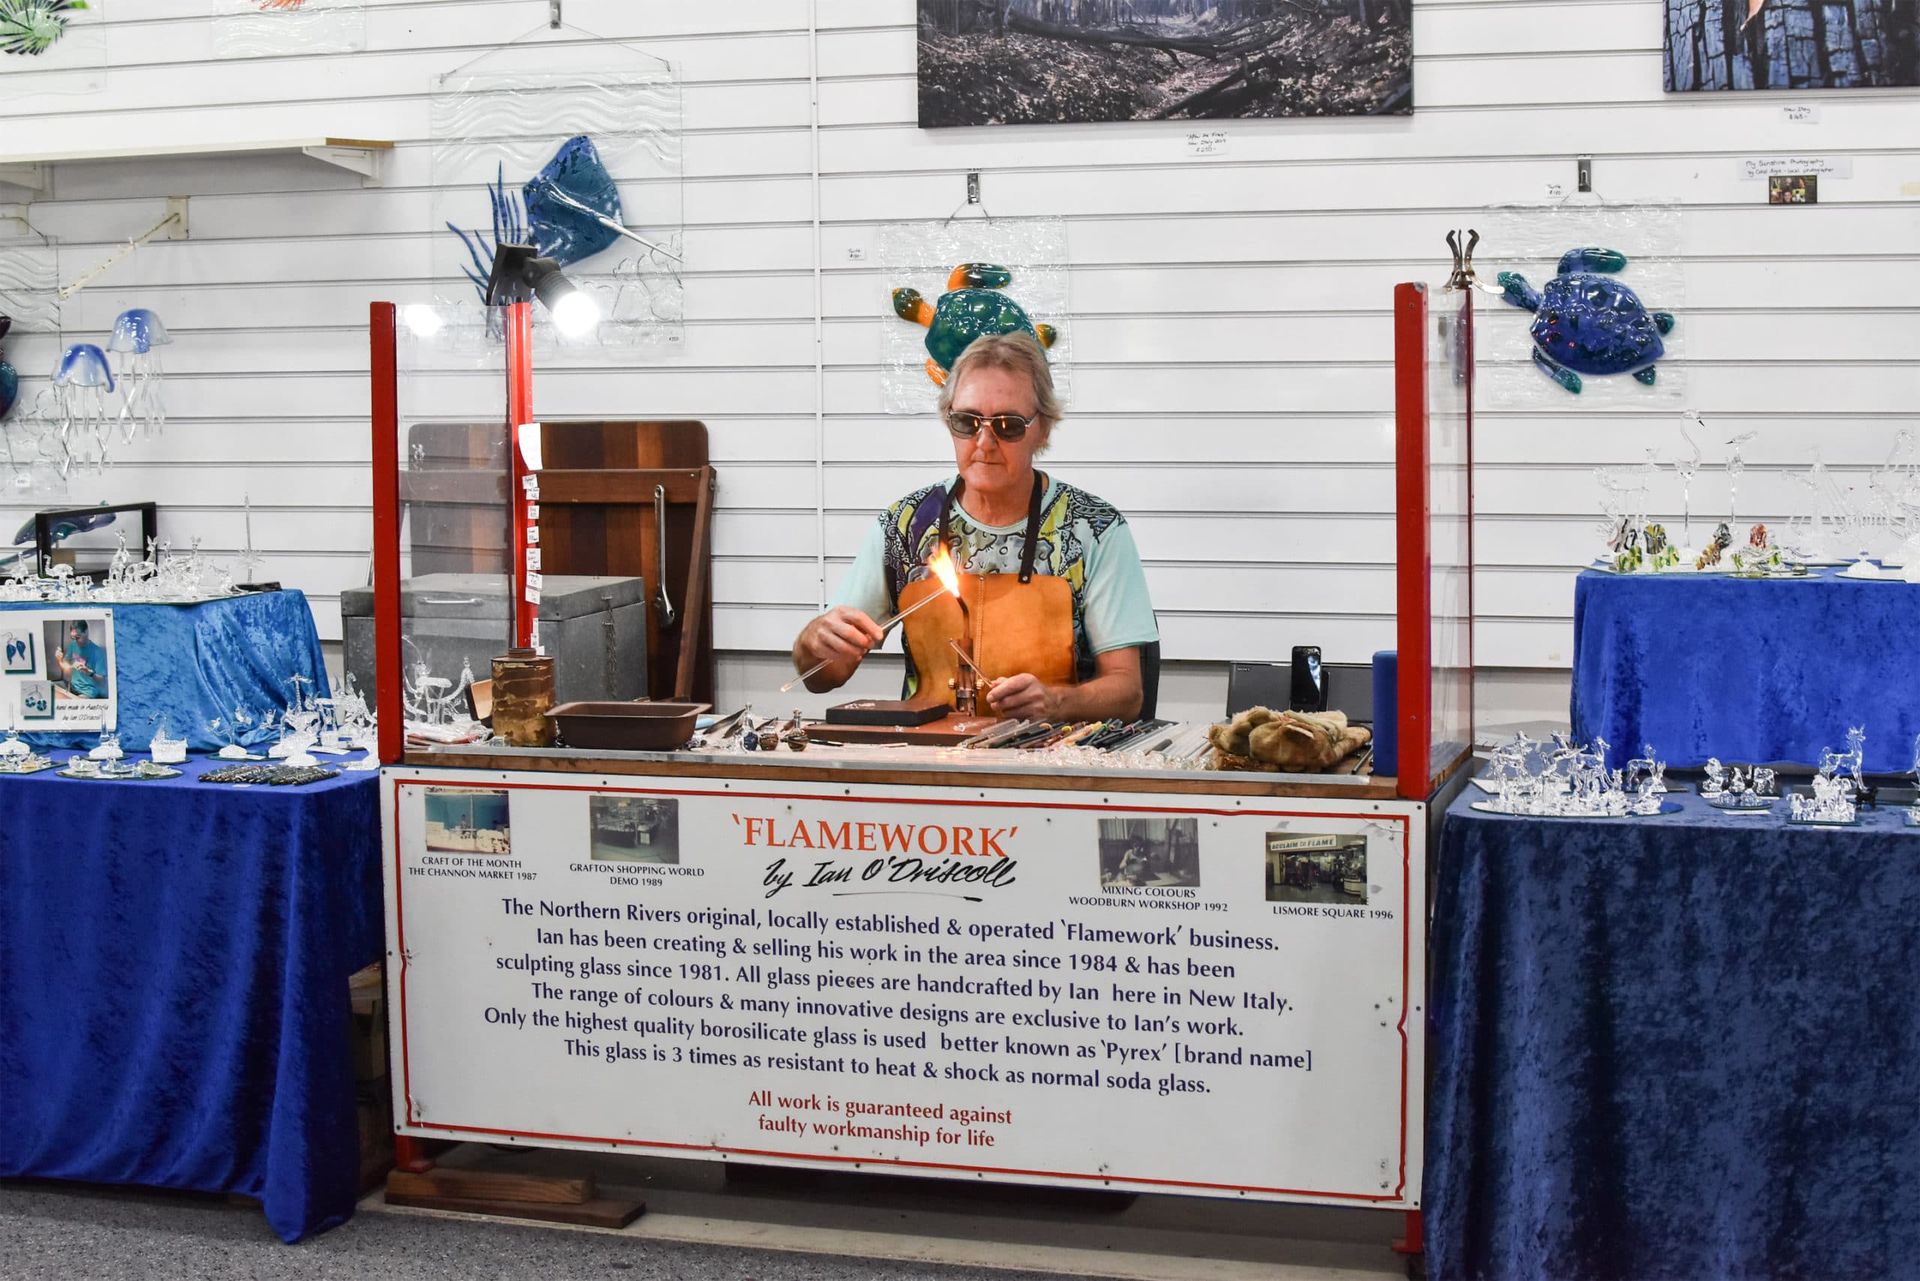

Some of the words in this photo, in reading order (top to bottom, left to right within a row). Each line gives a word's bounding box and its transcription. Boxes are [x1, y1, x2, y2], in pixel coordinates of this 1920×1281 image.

[408, 866, 426, 876] THE
[427, 867, 477, 878] CHANNON
[478, 870, 514, 880] MARKET
[517, 871, 538, 881] 1987
[421, 856, 450, 866] CRAFT
[451, 857, 464, 866] OF
[466, 858, 484, 867] THE
[485, 859, 522, 869] MONTH
[569, 862, 615, 873] GRAFTON
[616, 865, 667, 876] SHOPPING
[667, 867, 705, 877] WORLD
[763, 857, 793, 899] by
[802, 859, 852, 888] Ian
[861, 855, 1018, 888] O'Driscoll
[609, 876, 639, 886] DEMO
[641, 877, 663, 887] 1989
[1101, 886, 1142, 897] MIXING
[1145, 887, 1196, 899] COLOURS
[1068, 896, 1136, 908] WOODBURN
[1138, 899, 1201, 911] WORKSHOP
[1204, 902, 1229, 913] 1992
[1272, 905, 1319, 917] LISMORE
[1321, 908, 1366, 920] SQUARE
[1369, 909, 1394, 920] 1996
[500, 897, 534, 916] The
[539, 899, 621, 920] Northern
[626, 903, 682, 923] Rivers
[686, 906, 762, 931] original,
[768, 908, 829, 936] locally
[834, 913, 940, 935] established
[946, 918, 962, 936] &
[968, 920, 1055, 943] operated
[1189, 927, 1279, 951] business.
[536, 927, 564, 945] Ian
[569, 927, 599, 947] has
[604, 929, 647, 950] been
[652, 934, 727, 959] creating
[732, 937, 747, 955] &
[752, 937, 812, 964] selling
[817, 939, 844, 960] his
[849, 942, 898, 962] work
[903, 944, 922, 963] in
[927, 945, 959, 965] the
[964, 952, 1007, 967] area
[1012, 948, 1062, 970] since
[1068, 953, 1118, 973] 1984
[1124, 956, 1141, 974] &
[1147, 955, 1181, 976] has
[1187, 956, 1236, 979] been
[496, 952, 574, 978] sculpting
[579, 956, 622, 981] glass
[626, 959, 673, 979] since
[677, 962, 731, 982] 1981.
[735, 964, 761, 984] All
[766, 966, 811, 990] glass
[816, 969, 875, 993] pieces
[880, 977, 911, 991] are
[917, 972, 1033, 998] handcrafted
[1038, 978, 1062, 1005] by
[1069, 982, 1099, 1001] Ian
[1112, 982, 1157, 1004] here
[1163, 985, 1182, 1006] in
[1189, 988, 1236, 1008] New
[1243, 990, 1294, 1017] Italy.
[530, 981, 564, 1001] The
[569, 988, 619, 1009] range
[623, 986, 643, 1005] of
[647, 988, 714, 1009] colours
[719, 993, 734, 1010] &
[740, 998, 790, 1019] many
[796, 995, 894, 1019] innovative
[899, 1001, 969, 1028] designs
[974, 1010, 1006, 1025] are
[1011, 1008, 1101, 1030] exclusive
[1106, 1013, 1127, 1031] to
[1134, 1013, 1181, 1034] Ian's
[1186, 1016, 1244, 1037] work.
[484, 1006, 527, 1031] Only
[531, 1008, 560, 1028] the
[565, 1010, 629, 1035] highest
[633, 1016, 695, 1041] quality
[700, 1018, 808, 1043] borosilicate
[812, 1025, 858, 1049] glass
[863, 1027, 878, 1047] is
[883, 1030, 927, 1050] used
[940, 1031, 1000, 1054] better
[1005, 1035, 1070, 1057] known
[1075, 1045, 1097, 1059] as
[1174, 1042, 1243, 1066] [brand
[1249, 1049, 1312, 1072] name]
[563, 1038, 601, 1058] This
[605, 1040, 648, 1064] glass
[652, 1043, 667, 1062] is
[672, 1046, 683, 1063] 3
[688, 1046, 738, 1067] times
[742, 1054, 762, 1069] as
[767, 1052, 845, 1073] resistant
[850, 1057, 870, 1075] to
[875, 1056, 917, 1078] heat
[922, 1061, 938, 1079] &
[944, 1061, 1000, 1082] shock
[1005, 1070, 1026, 1084] as
[1031, 1068, 1100, 1088] normal
[1106, 1070, 1152, 1091] soda
[1158, 1072, 1211, 1097] glass.
[748, 1089, 772, 1107] All
[777, 1093, 822, 1111] work
[827, 1094, 840, 1113] is
[845, 1101, 944, 1120] guaranteed
[949, 1105, 1012, 1127] against
[757, 1113, 808, 1139] faulty
[812, 1119, 931, 1144] workmanship
[935, 1126, 962, 1145] for
[967, 1128, 995, 1147] life
